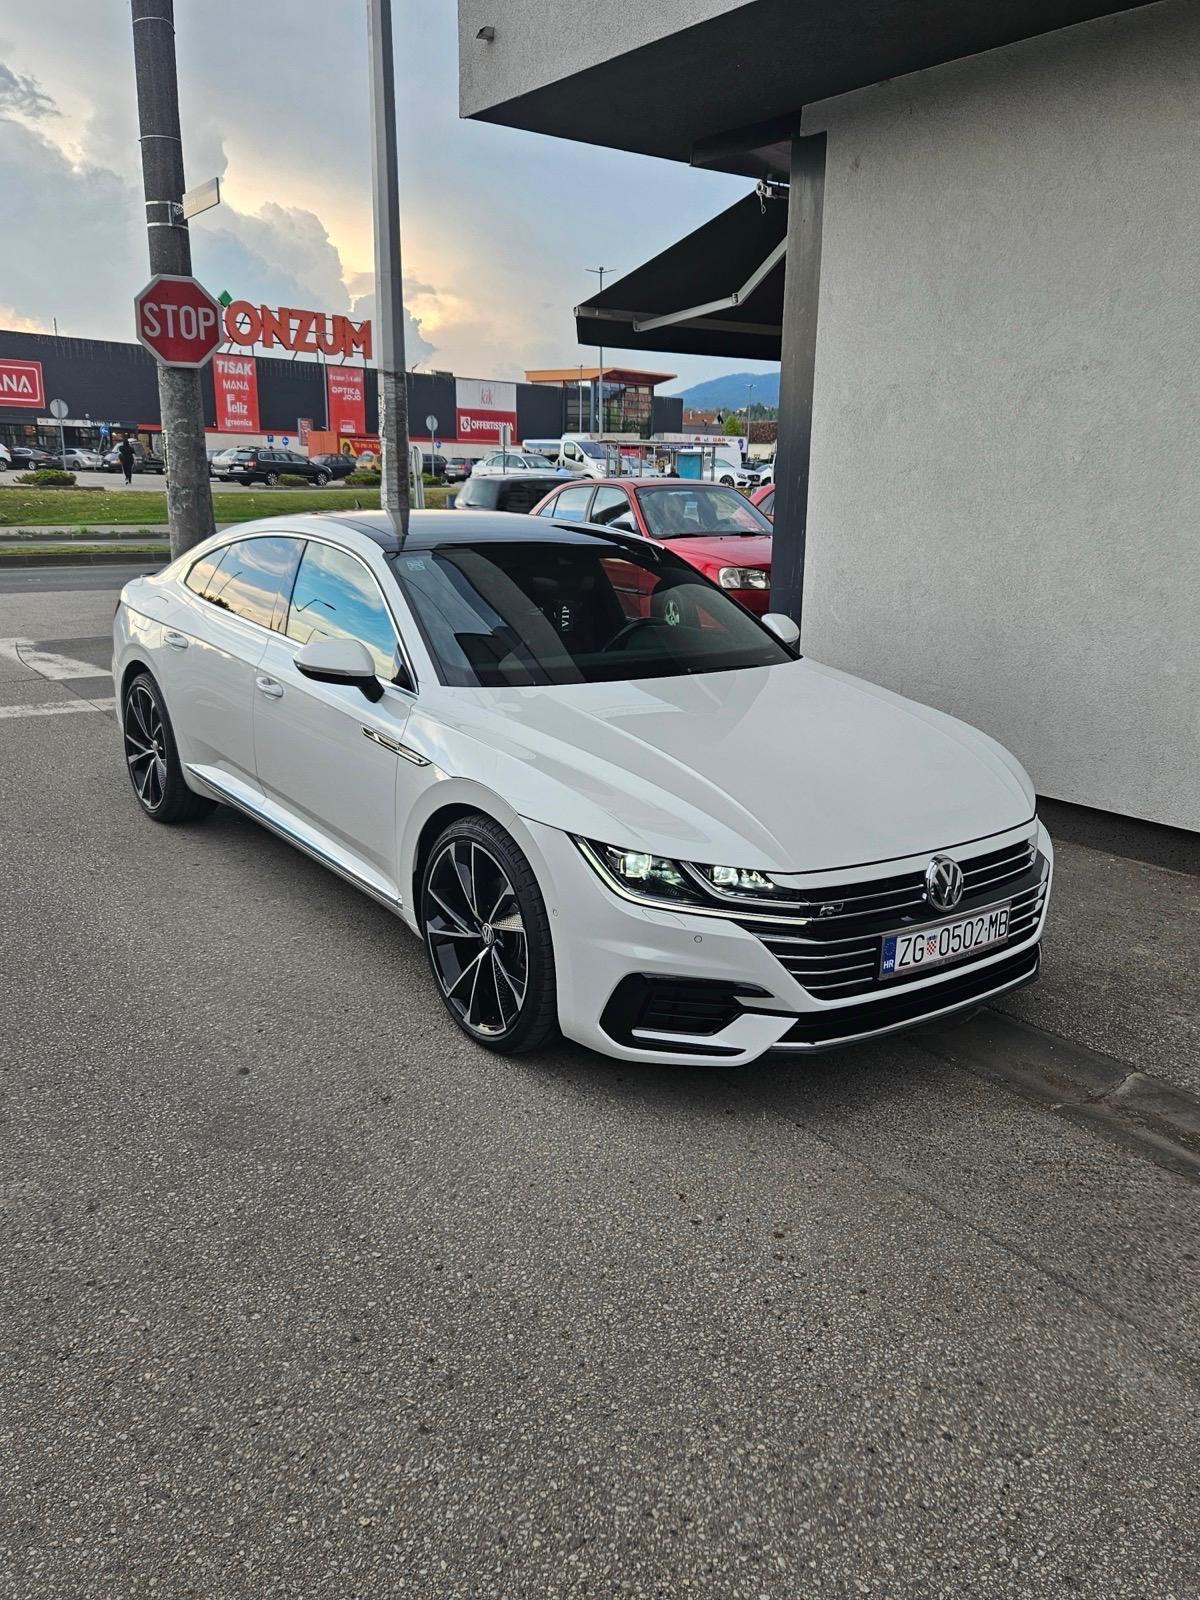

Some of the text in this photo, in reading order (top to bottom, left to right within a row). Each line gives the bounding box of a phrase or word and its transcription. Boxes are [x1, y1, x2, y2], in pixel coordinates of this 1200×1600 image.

[143, 303, 216, 341] STOP
[224, 300, 373, 360] ONZUM
[216, 360, 253, 375] TISAK
[222, 379, 250, 391] MANA
[331, 386, 361, 395] OPTIKA
[561, 605, 570, 627] VIP
[898, 934, 926, 967] ZG
[883, 959, 895, 970] HR
